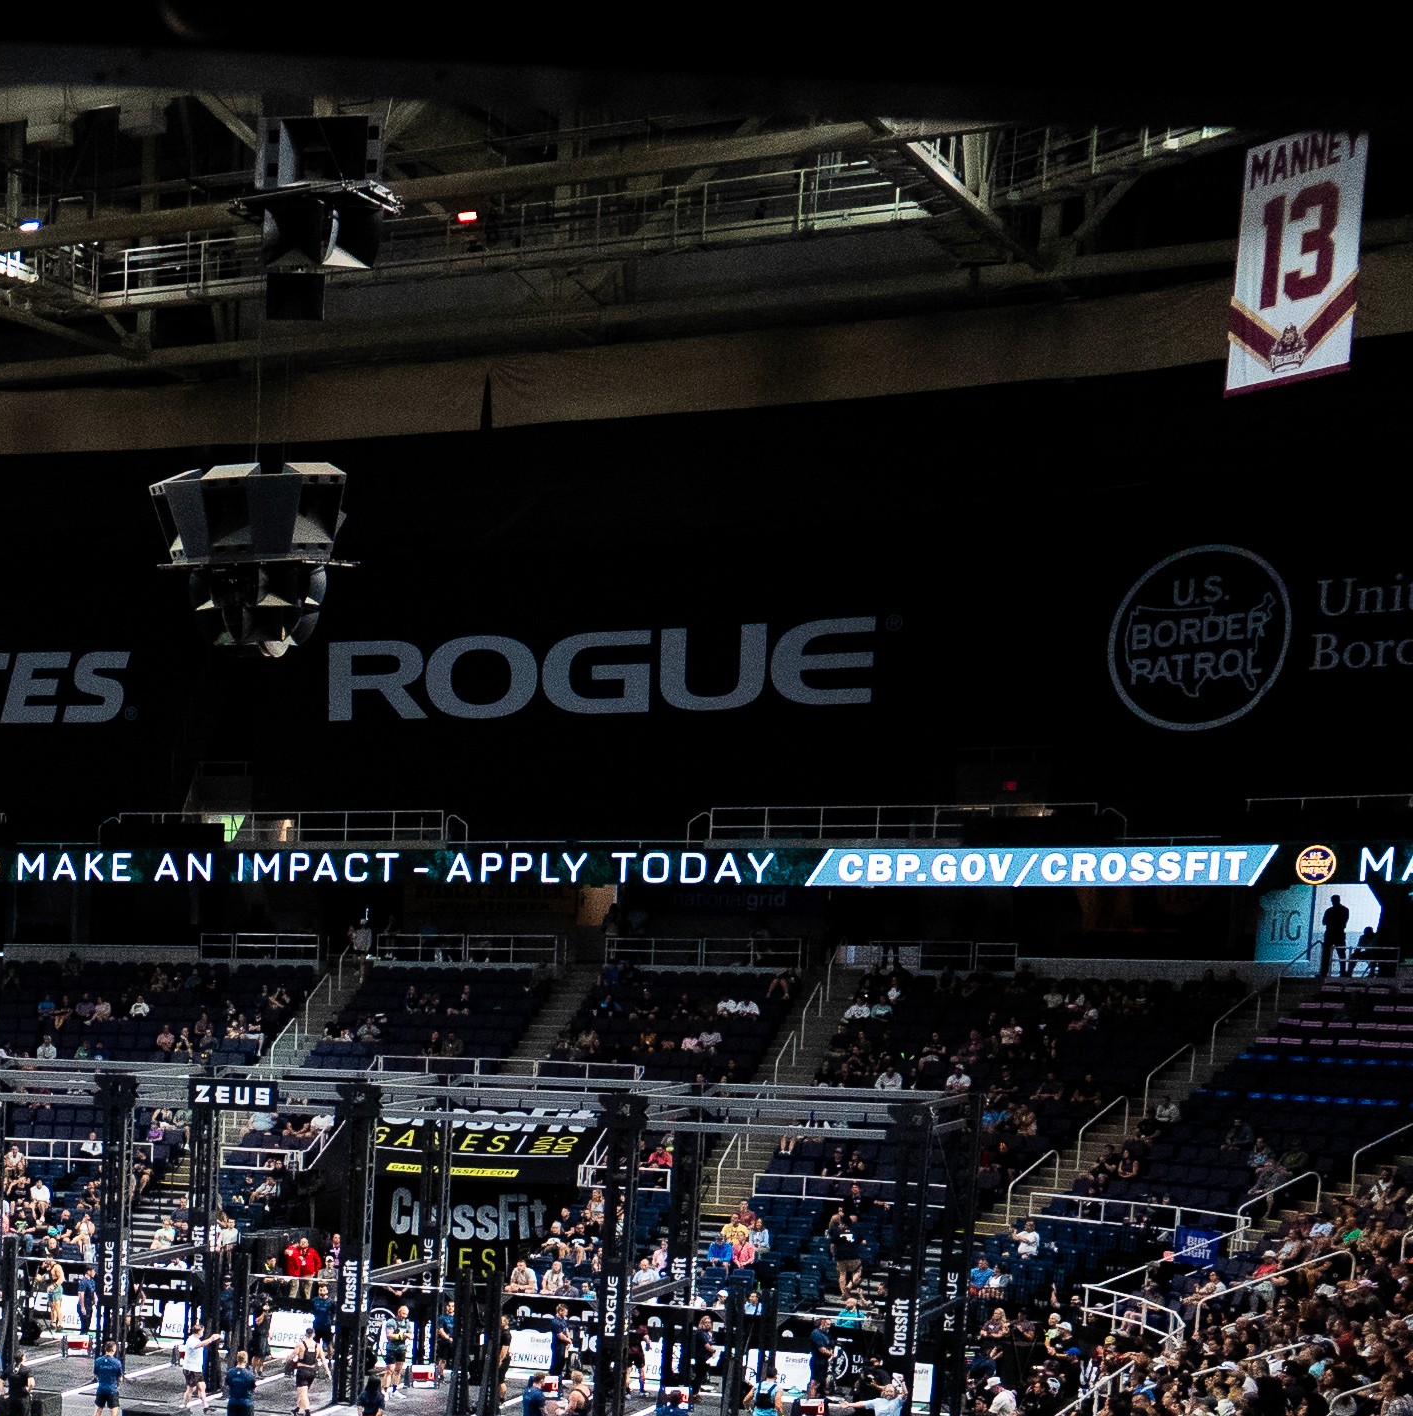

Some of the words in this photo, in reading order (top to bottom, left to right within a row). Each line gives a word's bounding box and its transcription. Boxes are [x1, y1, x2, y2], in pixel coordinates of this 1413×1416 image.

[1260, 181, 1341, 310] 13
[1173, 575, 1229, 606] U.S.
[1131, 611, 1265, 650] BORDER
[325, 613, 881, 725] ROGUE
[1130, 649, 1263, 685] PATROL
[18, 852, 133, 882] MAKE
[154, 852, 212, 882] AN
[238, 852, 401, 883] IMPACT
[447, 853, 586, 883] APPLY
[612, 852, 774, 882] TODAY
[195, 1085, 271, 1105] ZEUS
[103, 1241, 115, 1297] ROGUE
[341, 1260, 358, 1313] CrossFit
[604, 1276, 618, 1337] ROGUE
[889, 1299, 909, 1356] CrossFit
